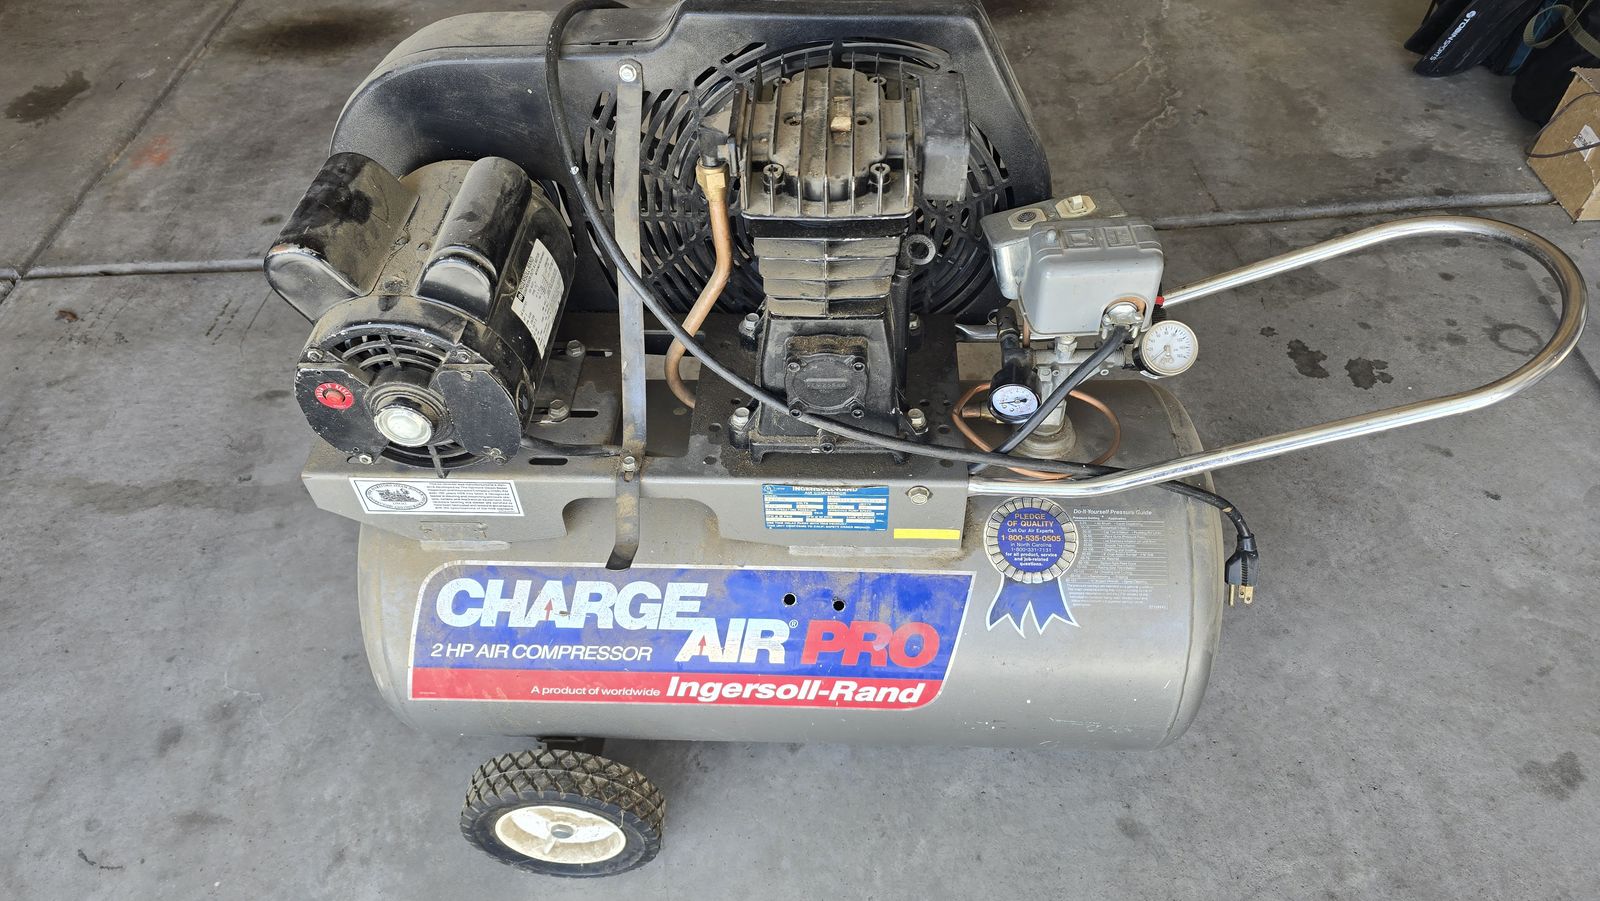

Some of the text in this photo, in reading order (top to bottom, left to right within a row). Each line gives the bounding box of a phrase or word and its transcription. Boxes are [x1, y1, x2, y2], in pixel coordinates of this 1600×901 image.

[436, 578, 709, 630] CHARGE
[431, 643, 653, 661] 2 HP AIR COMPRESSOR
[801, 619, 940, 668] PRO
[530, 676, 926, 703] A product of worldwide Ingersoll-Rand
